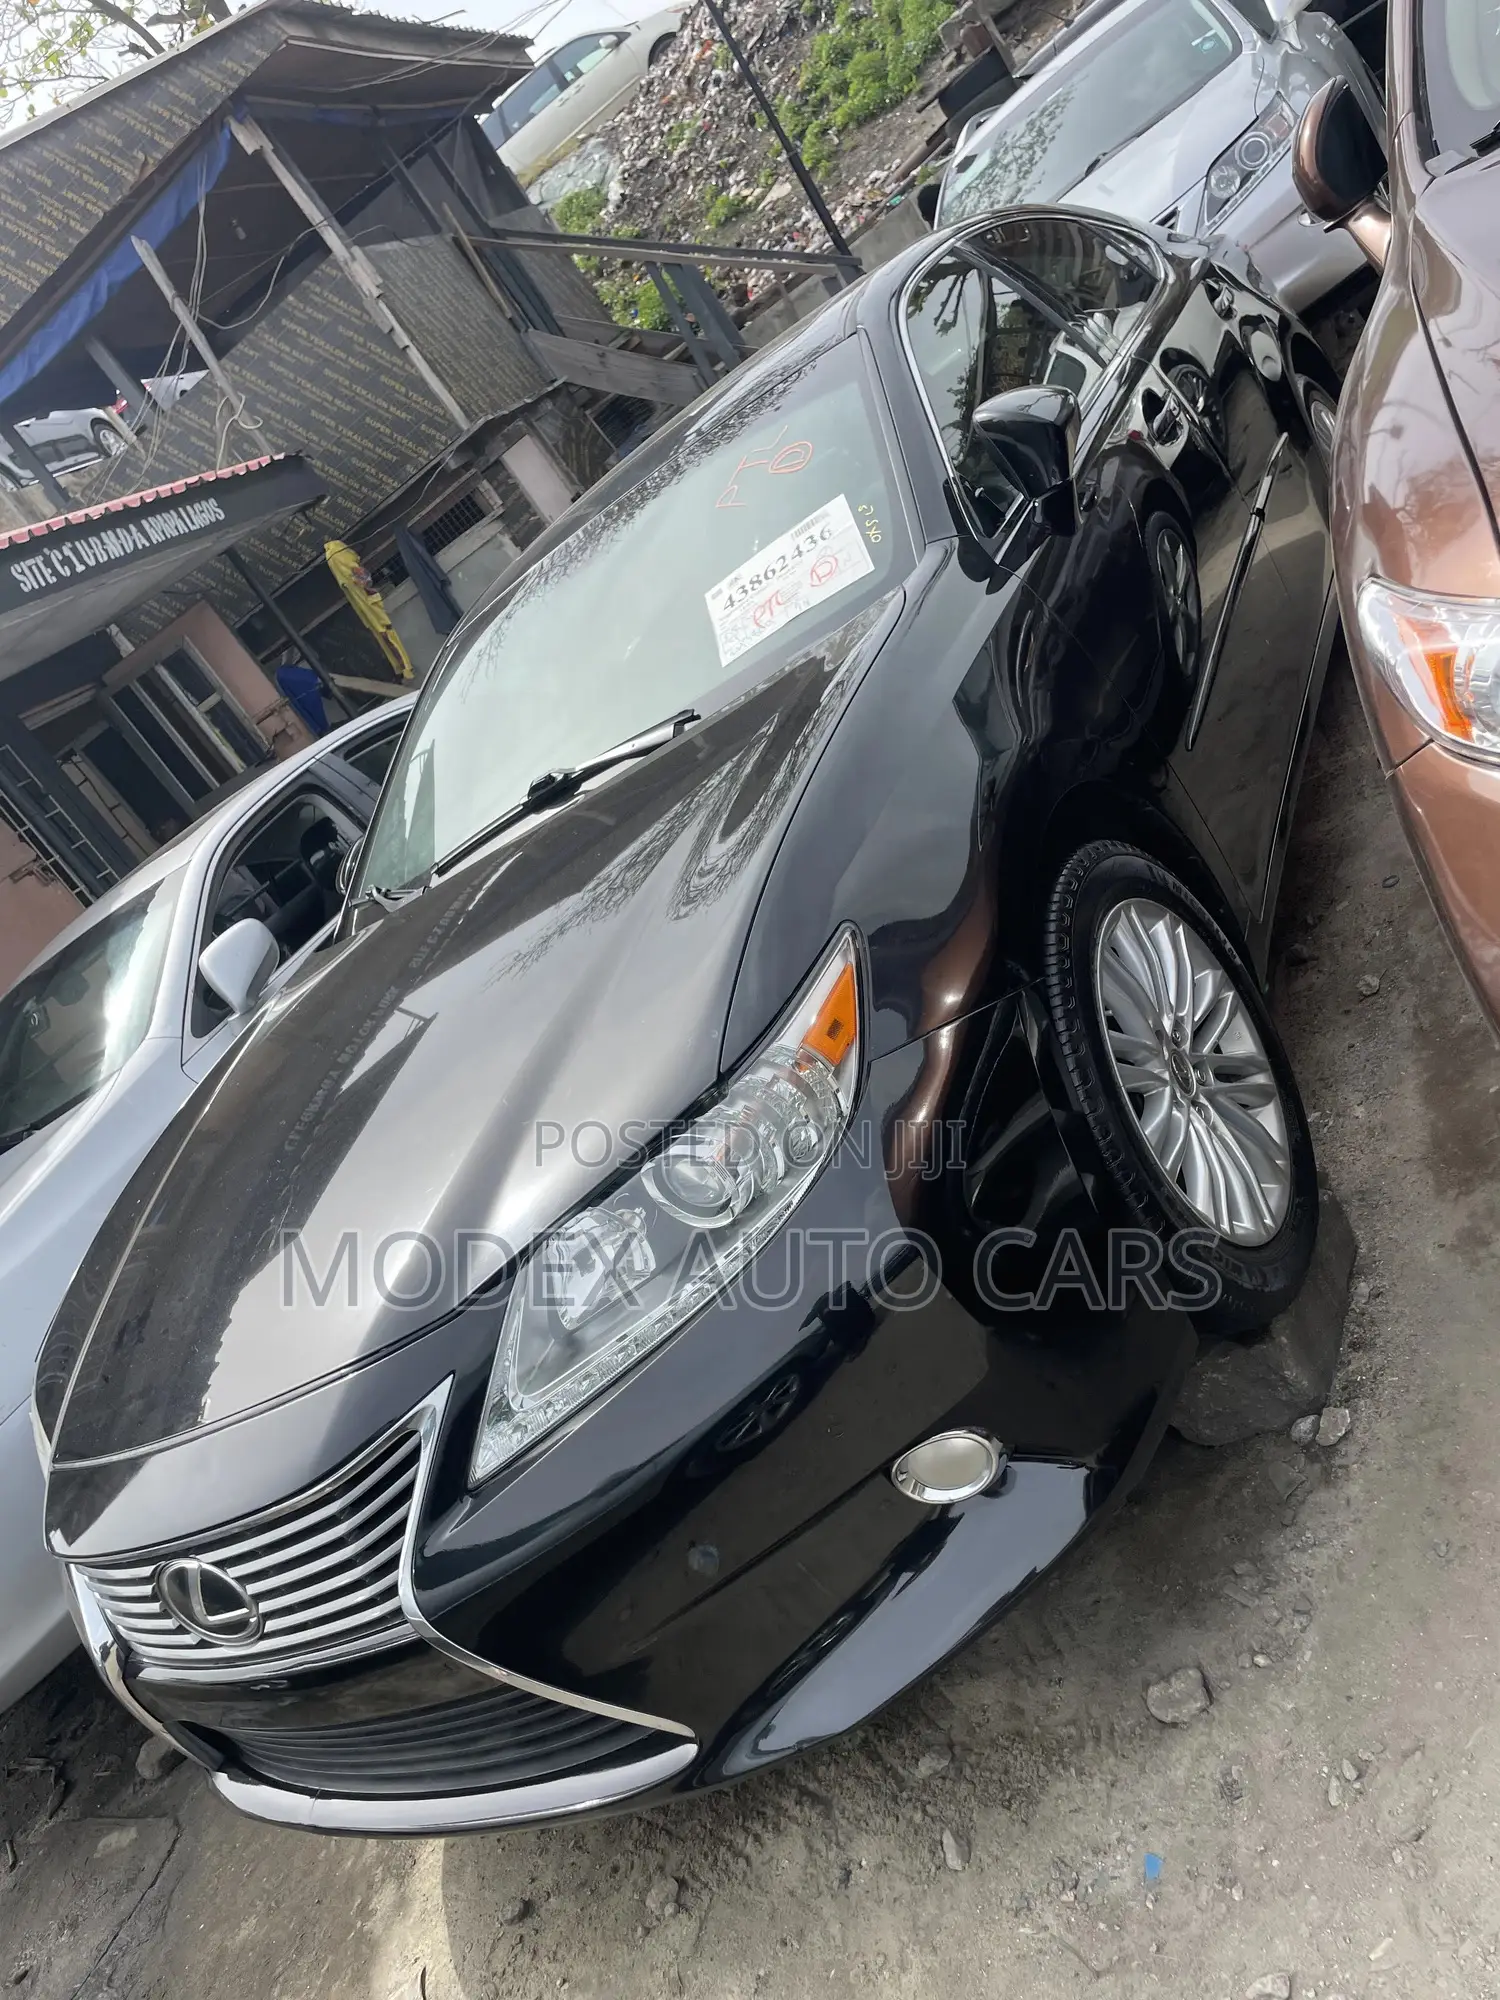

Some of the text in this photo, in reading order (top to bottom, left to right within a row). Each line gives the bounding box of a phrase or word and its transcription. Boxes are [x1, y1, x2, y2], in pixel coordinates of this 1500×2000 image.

[336, 424, 373, 449] YEKALON
[374, 446, 397, 463] MART
[364, 416, 390, 435] SUPER
[391, 432, 430, 458] YEKALON
[10, 555, 58, 593] SITE
[178, 497, 226, 532] LAGOS
[723, 522, 832, 612] 43862436
